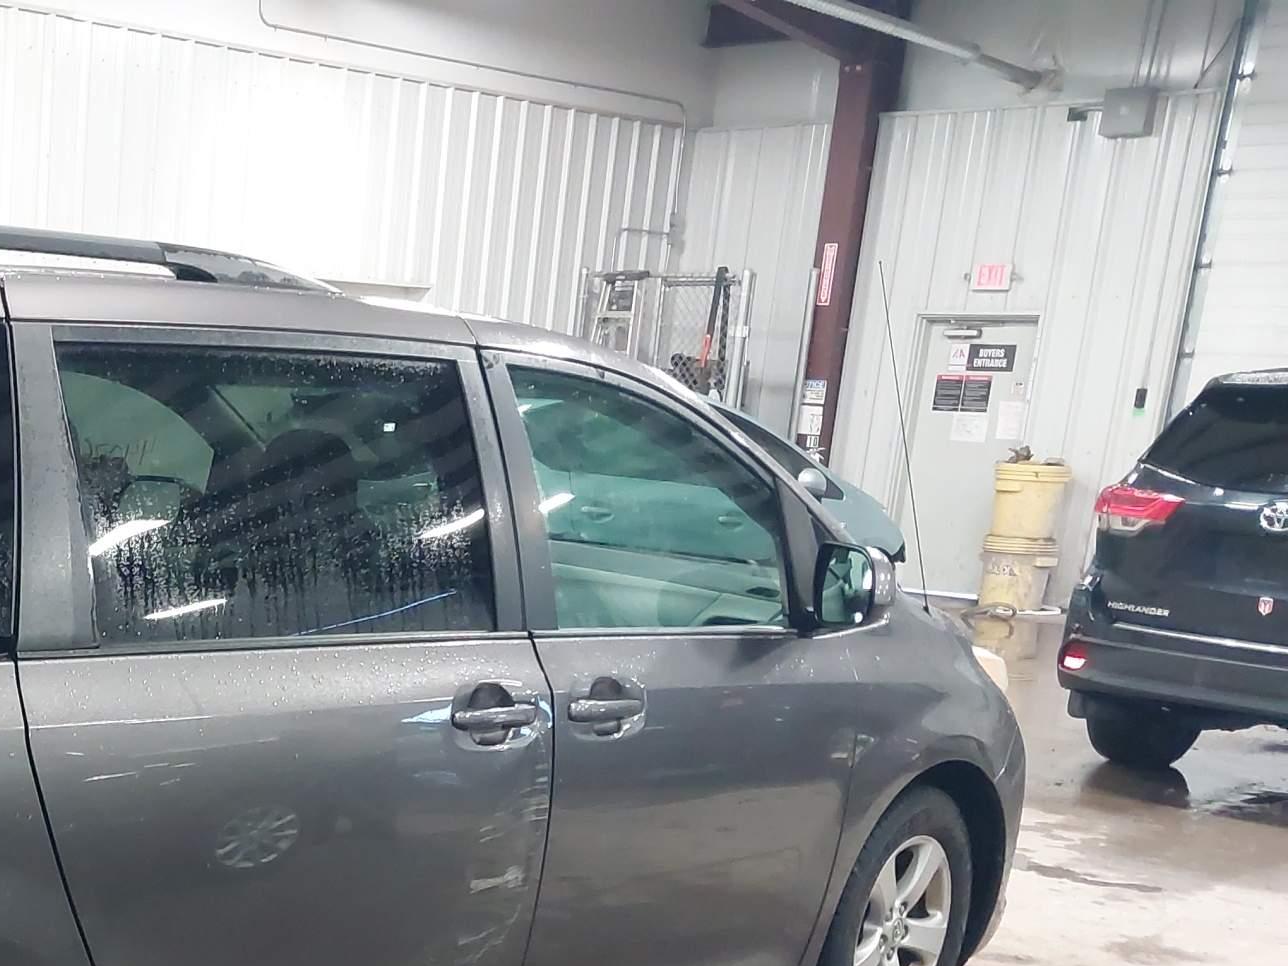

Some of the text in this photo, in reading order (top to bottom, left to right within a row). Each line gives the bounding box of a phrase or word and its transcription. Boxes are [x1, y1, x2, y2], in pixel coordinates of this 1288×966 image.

[977, 264, 1007, 287] EXIT
[979, 348, 1006, 358] BUYERS
[973, 358, 1007, 368] ENTRANCE
[1107, 600, 1171, 617] HIGHLANDER
